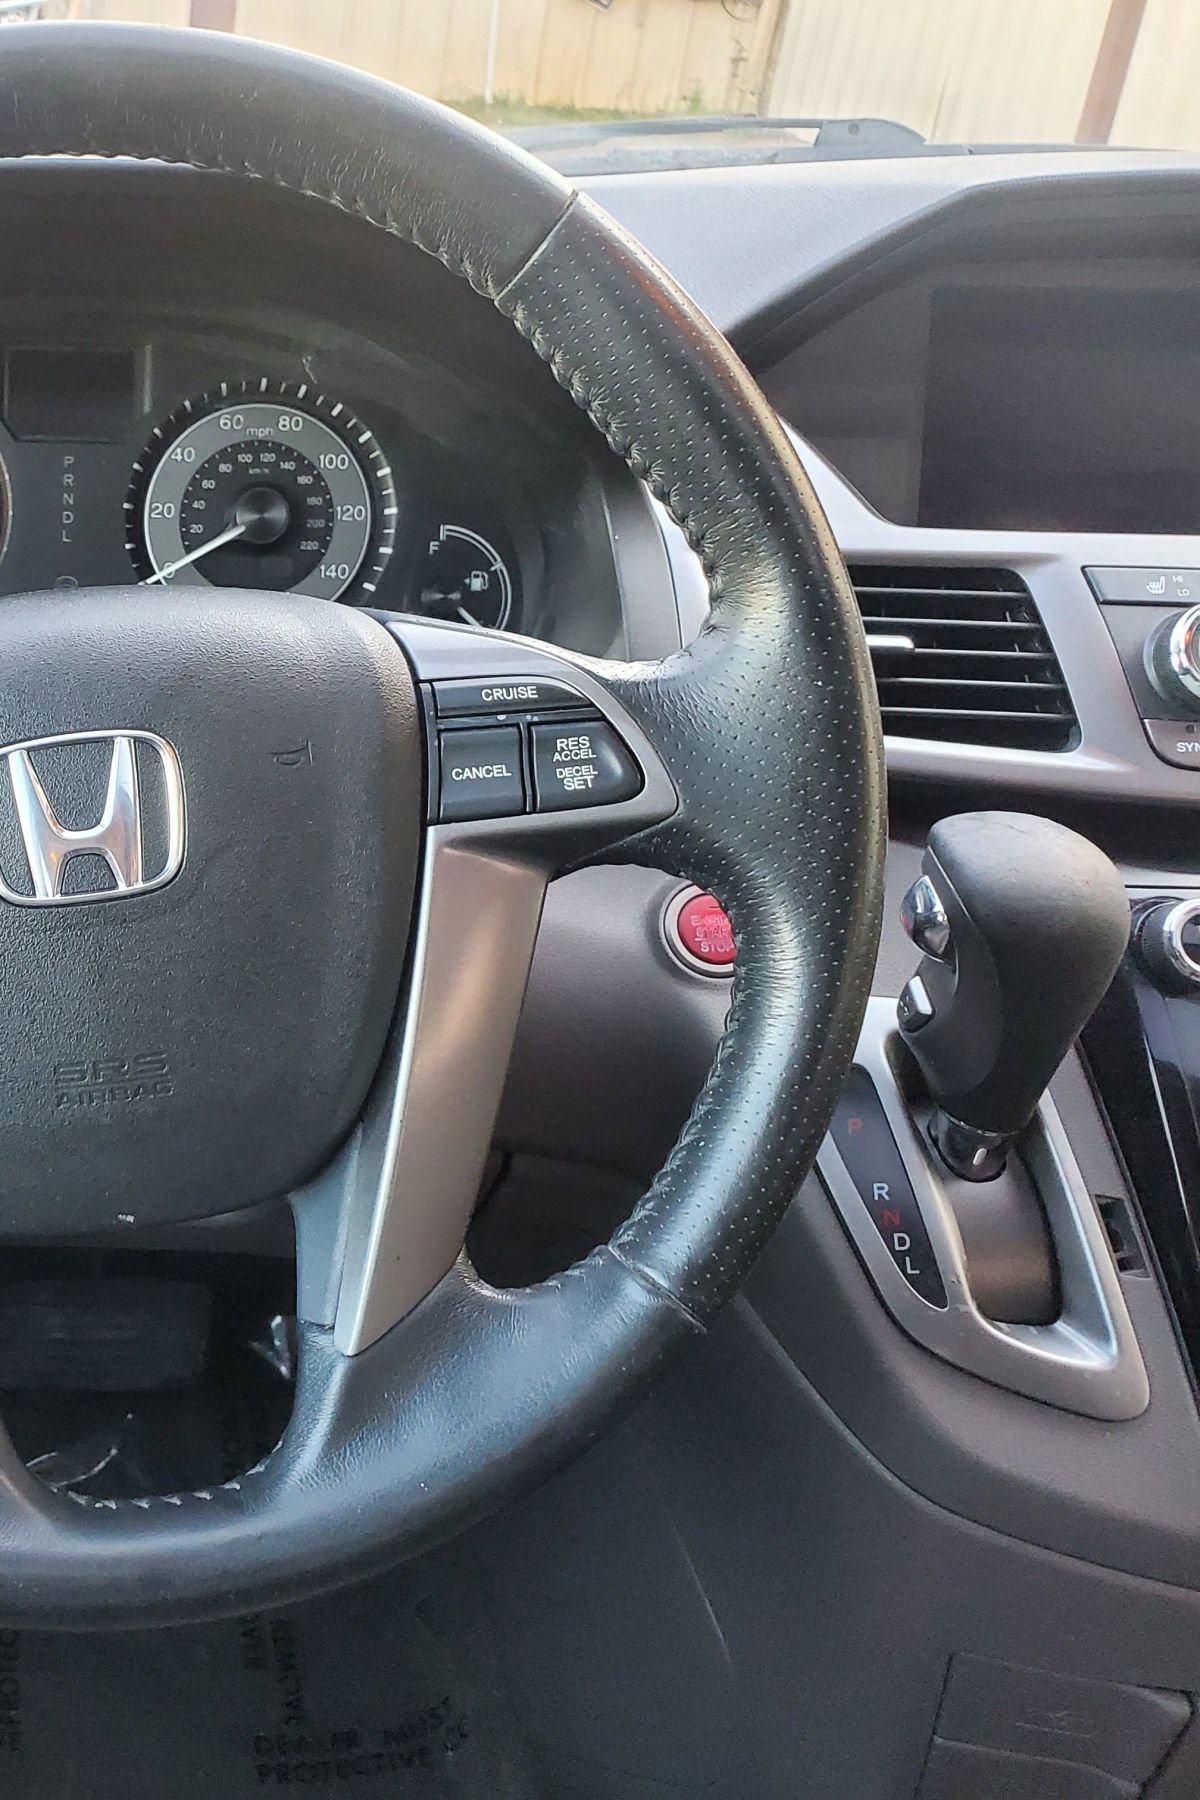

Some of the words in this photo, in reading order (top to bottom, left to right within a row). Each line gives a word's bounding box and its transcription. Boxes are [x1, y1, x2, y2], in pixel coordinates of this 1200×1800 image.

[219, 414, 244, 431] 60
[278, 415, 303, 433] 80
[246, 425, 275, 439] mph
[63, 455, 75, 468] P
[170, 446, 195, 463] 40
[237, 453, 253, 463] 100
[260, 452, 277, 462] 120
[318, 452, 349, 471] 100
[218, 462, 233, 473] 80
[279, 460, 296, 471] 140
[63, 473, 75, 487] R
[201, 479, 216, 489] 60
[62, 492, 74, 505] N
[192, 500, 206, 509] 40
[62, 511, 74, 524] D
[150, 502, 175, 519] 20
[335, 504, 366, 522] 120
[62, 529, 73, 542] L
[189, 524, 204, 533] 20
[300, 540, 319, 550] 220
[428, 540, 440, 556] F
[319, 562, 350, 580] 140
[481, 685, 539, 702] CRUISE
[556, 735, 590, 751] RES
[552, 748, 597, 763] ACCEL
[451, 764, 512, 781] CANCEL
[556, 764, 598, 779] DECEL
[563, 775, 595, 791] SET
[52, 1052, 169, 1086] SRS
[56, 1081, 177, 1109] AIRBAG
[848, 1117, 863, 1134] P
[873, 1182, 891, 1201] R
[882, 1208, 900, 1226] N
[893, 1232, 911, 1251] D
[905, 1256, 920, 1275] L
